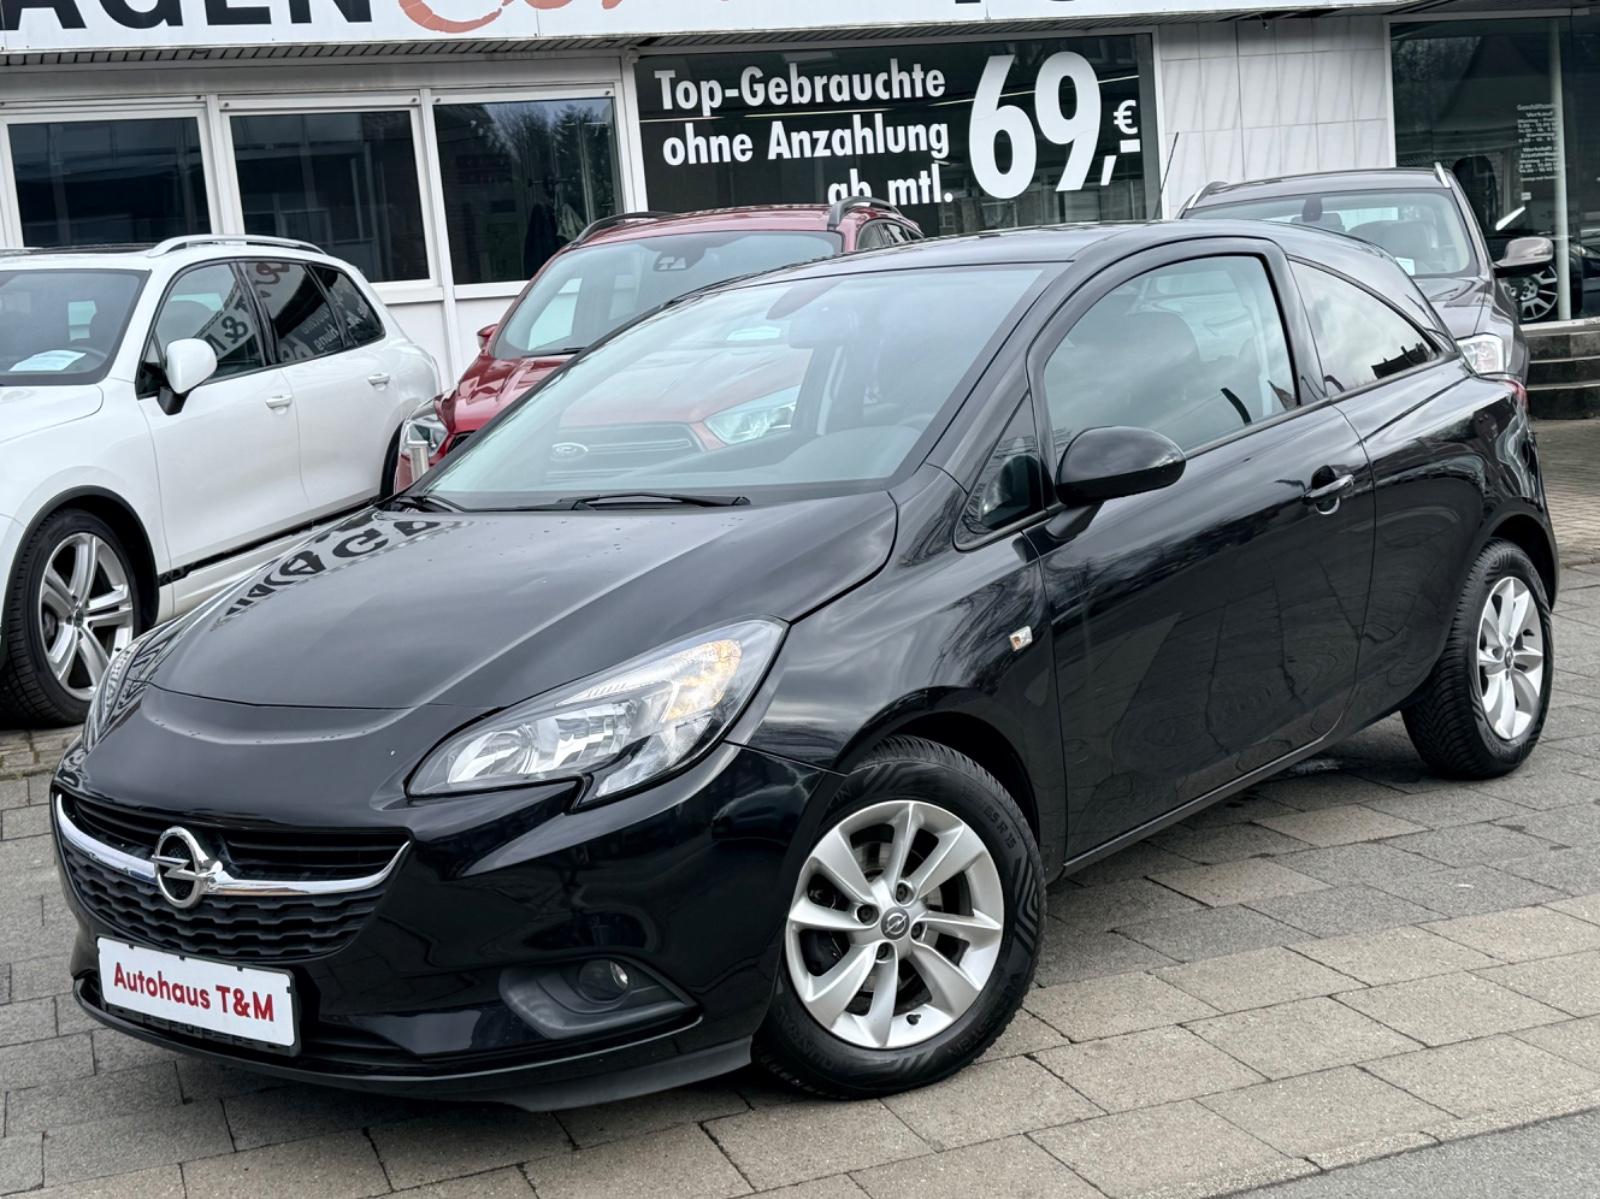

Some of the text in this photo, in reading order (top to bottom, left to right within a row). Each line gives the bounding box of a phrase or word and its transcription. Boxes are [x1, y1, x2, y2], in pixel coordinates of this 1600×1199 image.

[654, 59, 946, 115] Top-Gebrauchte
[662, 113, 951, 167] ohne Anzahlung
[1112, 98, 1139, 135] €
[827, 162, 954, 207] ab mtl.
[114, 962, 274, 1022] Autohaus T&M
